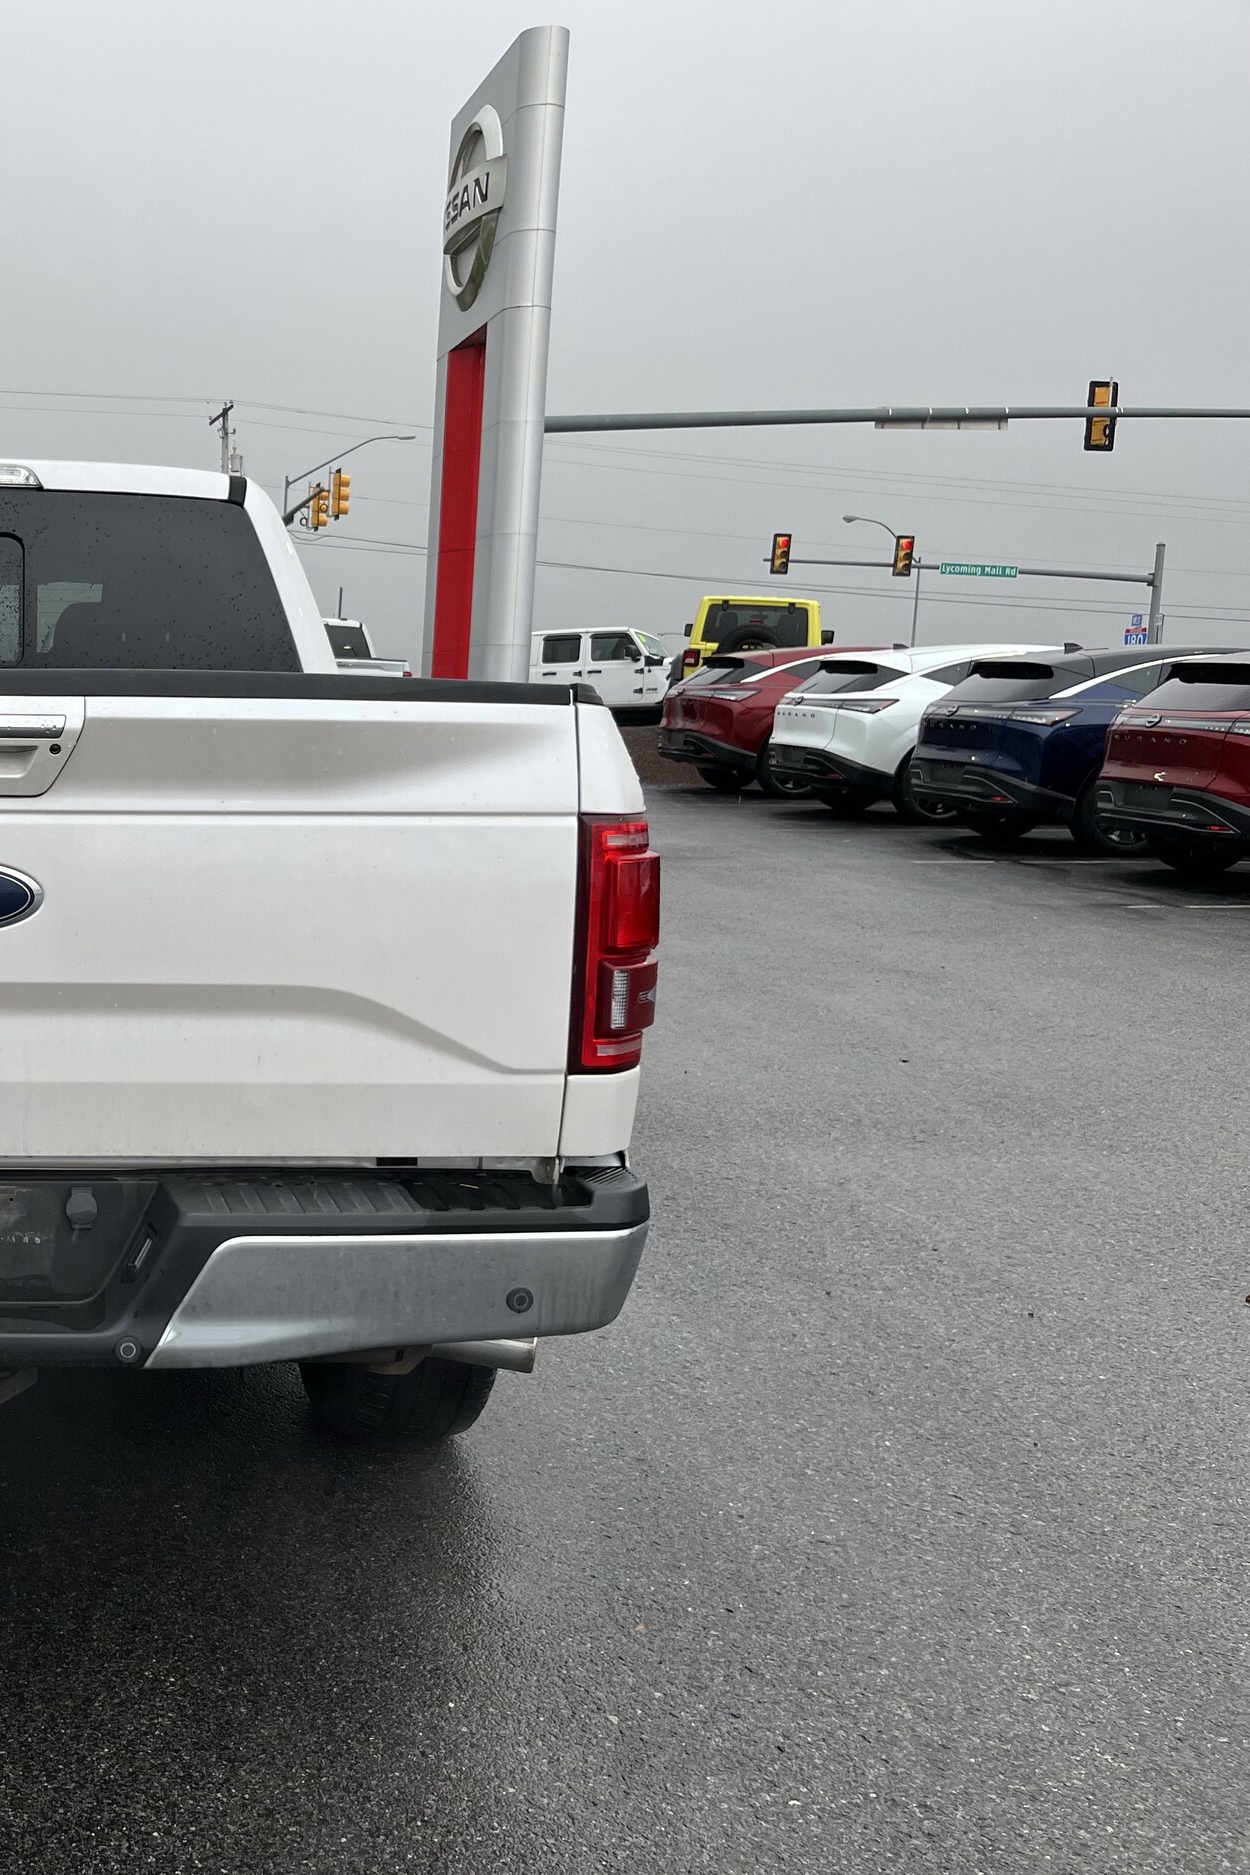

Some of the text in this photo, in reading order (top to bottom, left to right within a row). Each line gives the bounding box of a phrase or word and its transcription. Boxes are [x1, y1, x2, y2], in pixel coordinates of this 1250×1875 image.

[445, 172, 490, 231] SSAN
[942, 563, 1016, 576] Lycoming Mall Rd
